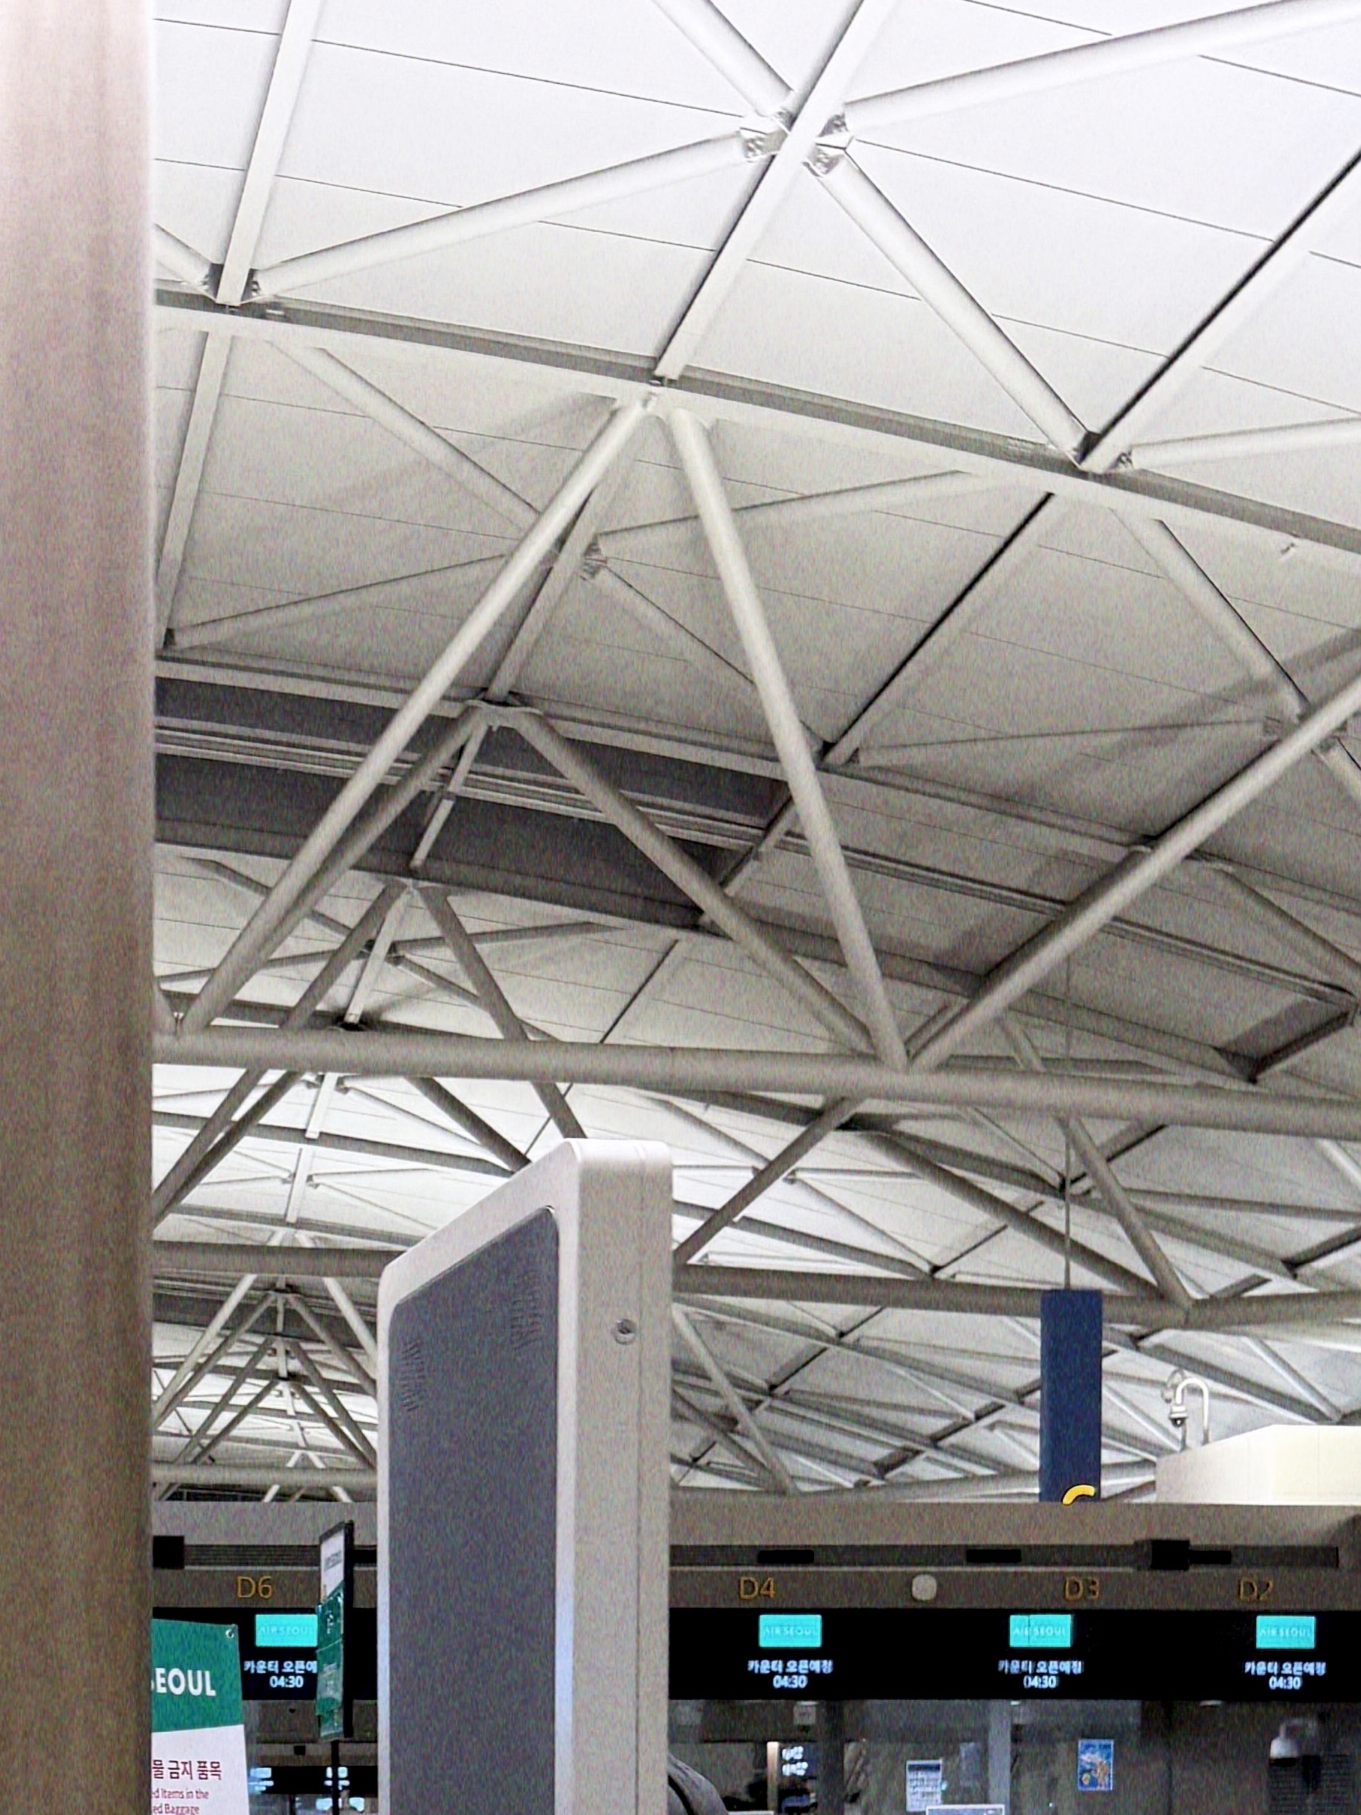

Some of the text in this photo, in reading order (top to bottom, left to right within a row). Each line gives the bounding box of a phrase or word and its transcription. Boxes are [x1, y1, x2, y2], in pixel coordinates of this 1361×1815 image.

[237, 1576, 273, 1598] D6
[739, 1576, 776, 1599] D4
[1065, 1576, 1100, 1599] D3
[1240, 1577, 1273, 1600] D2
[281, 1660, 318, 1673] 오픈예
[151, 1667, 217, 1697] EOUL
[269, 1675, 304, 1688] 04:30
[772, 1675, 808, 1688] 04:30
[1023, 1674, 1058, 1688] 04:30
[1268, 1676, 1302, 1690] 04:30
[167, 1760, 193, 1780] 금지
[197, 1760, 222, 1781] 품목
[161, 1788, 185, 1799] Items
[186, 1788, 194, 1799] in
[195, 1788, 209, 1799] the
